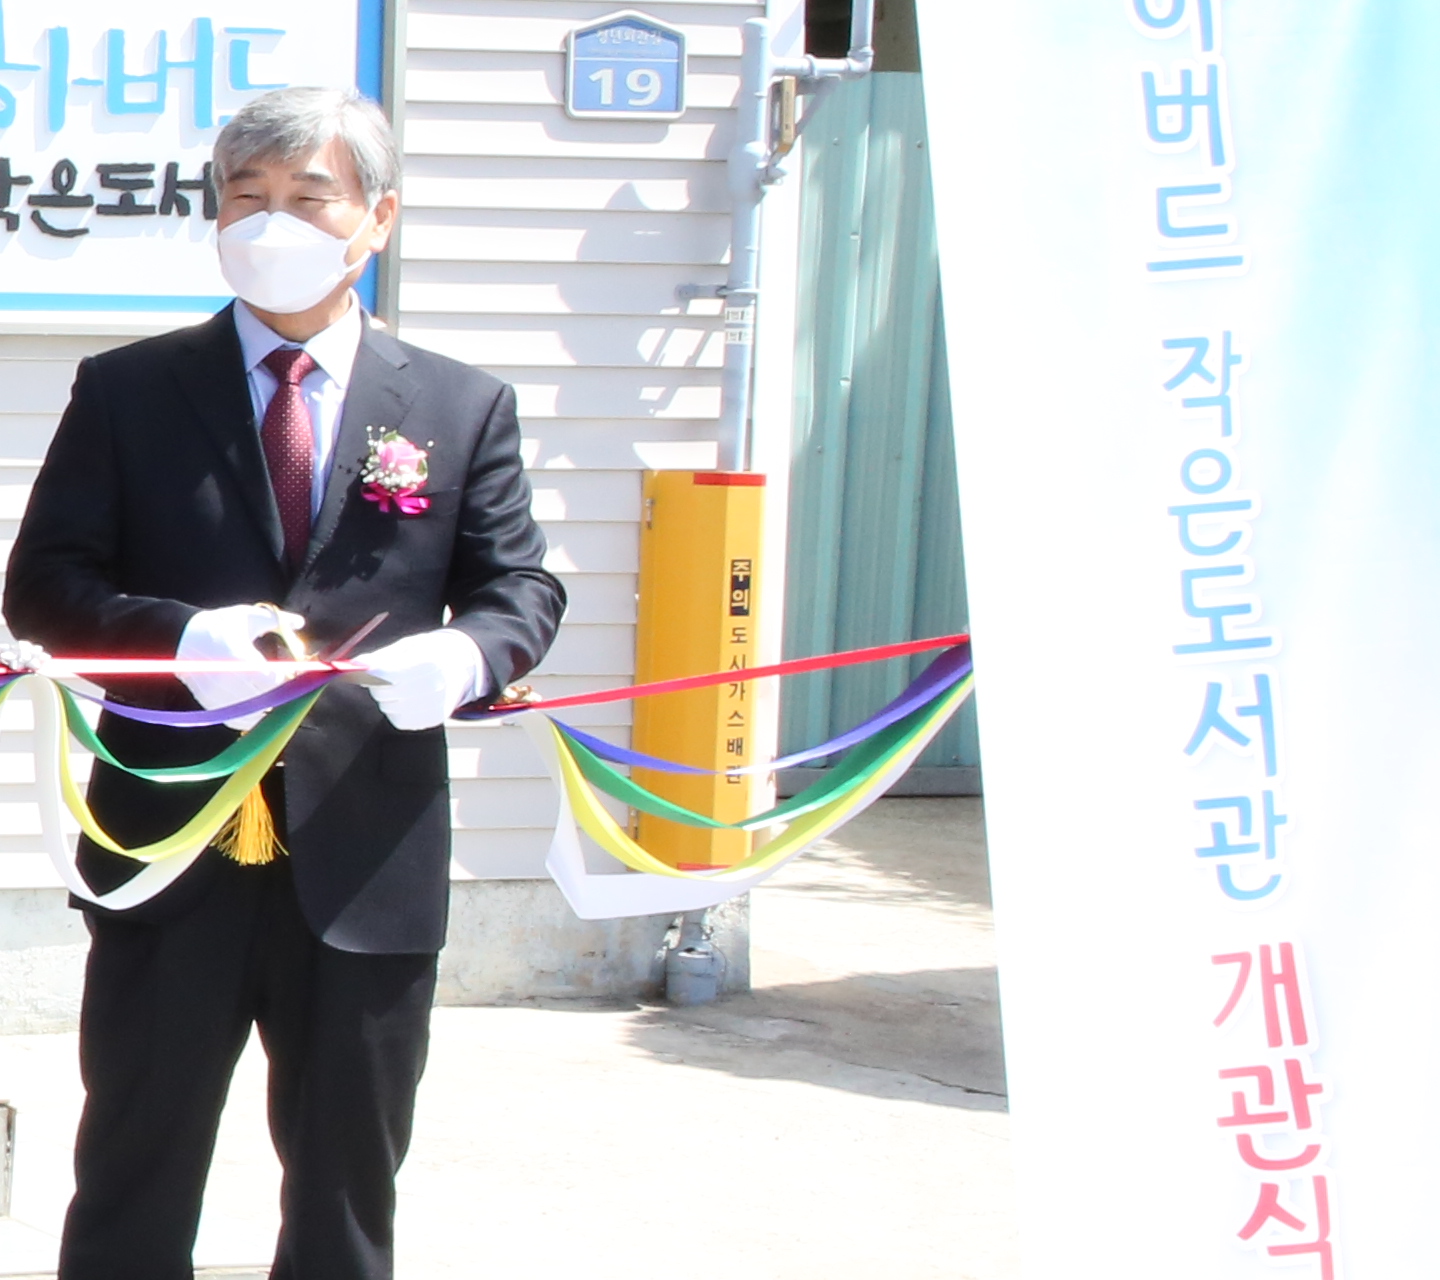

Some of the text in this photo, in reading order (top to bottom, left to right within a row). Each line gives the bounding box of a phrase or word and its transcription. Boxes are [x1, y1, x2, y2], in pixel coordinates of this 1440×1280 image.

[588, 67, 662, 107] 19
[730, 560, 750, 612] 주의
[1162, 330, 1288, 901] 작은도서관
